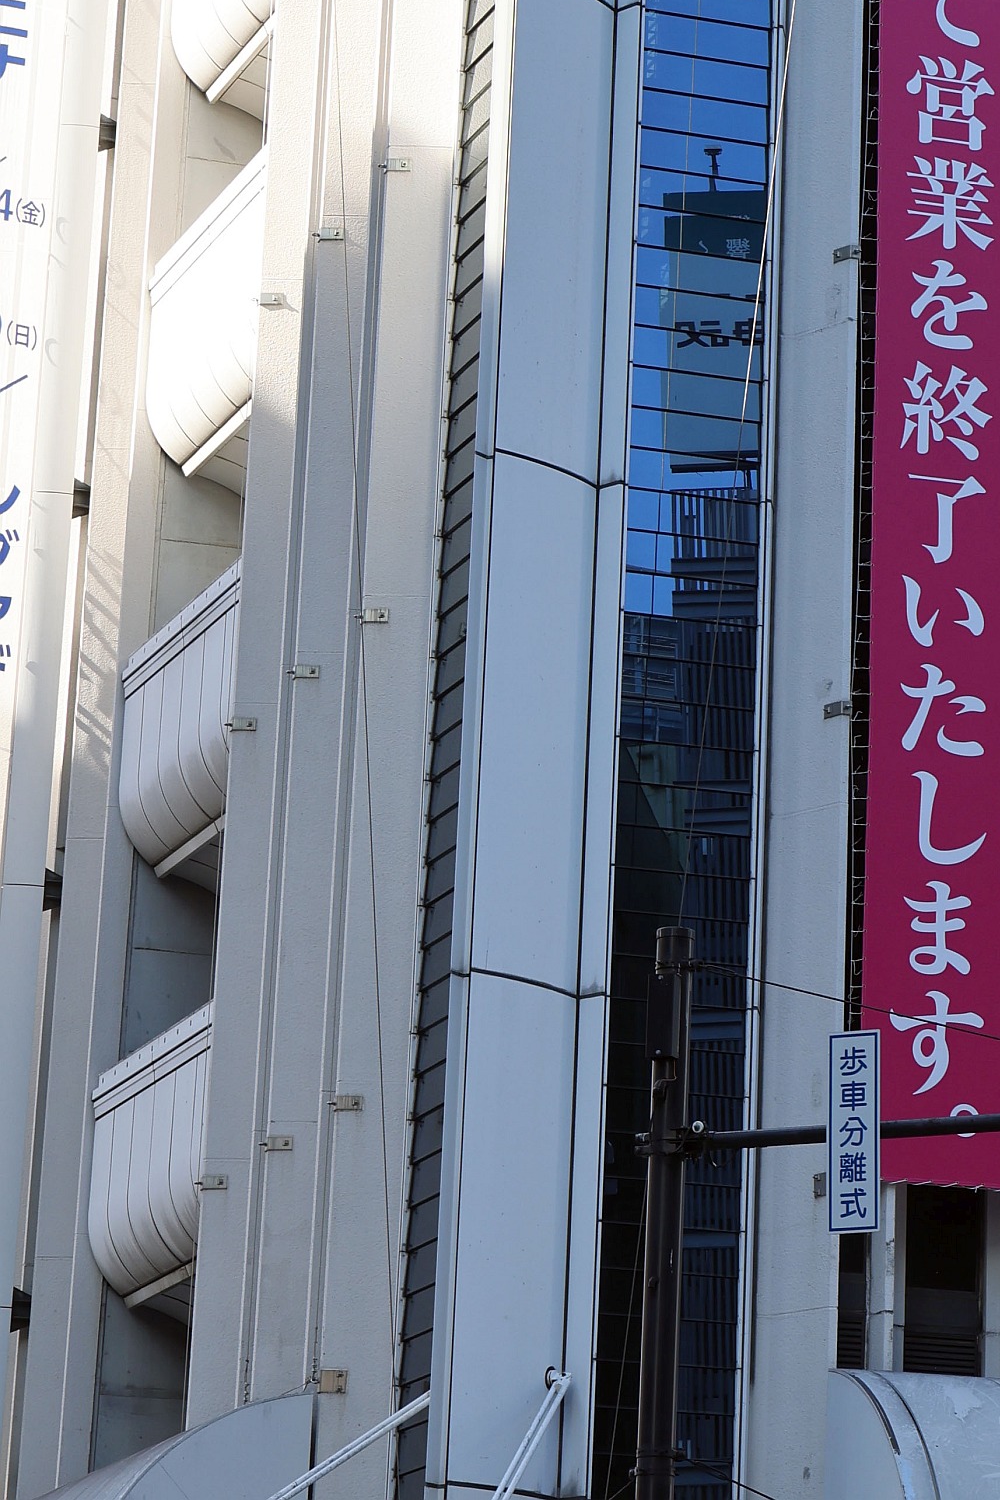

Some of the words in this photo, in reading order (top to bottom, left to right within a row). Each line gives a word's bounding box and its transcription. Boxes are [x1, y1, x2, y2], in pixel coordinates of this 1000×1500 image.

[838, 1046, 868, 1219] 歩車分離式
